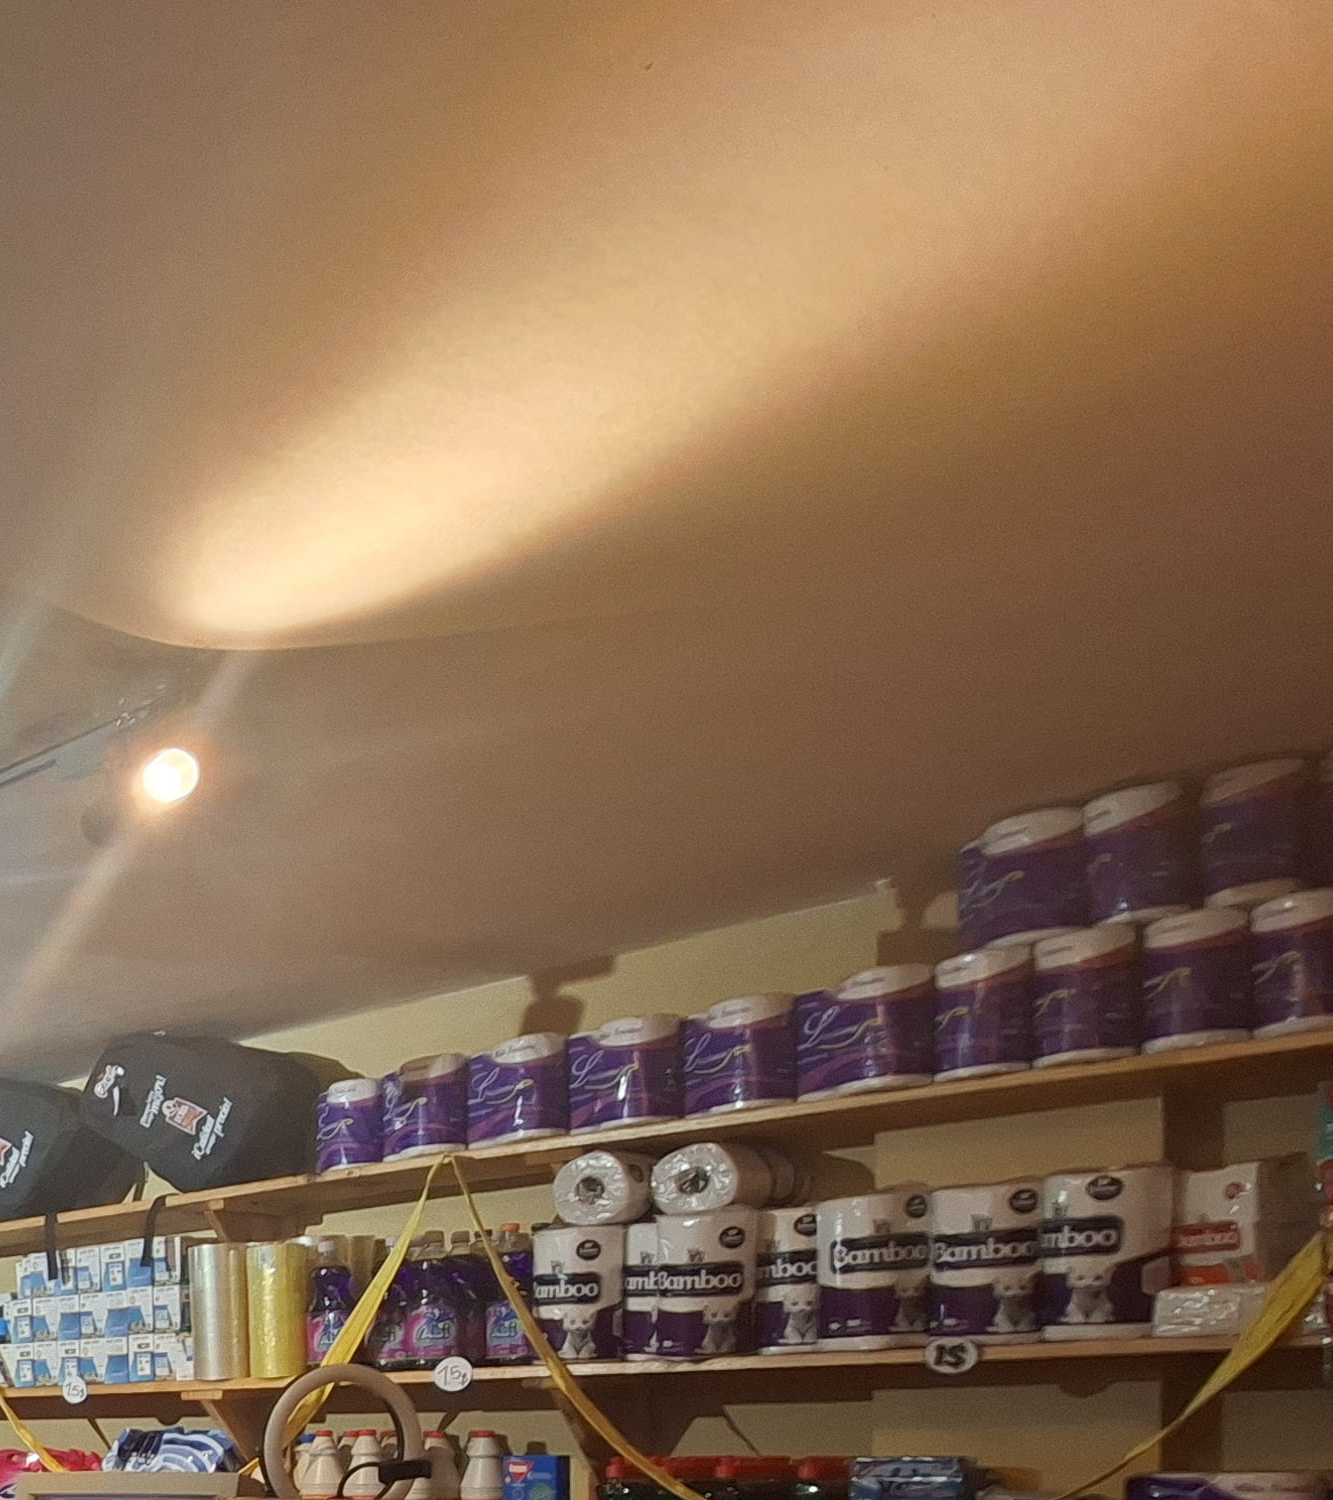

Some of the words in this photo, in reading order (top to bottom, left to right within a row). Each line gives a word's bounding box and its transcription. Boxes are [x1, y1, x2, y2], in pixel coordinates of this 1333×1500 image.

[1041, 1224, 1118, 1250] mboo
[763, 1250, 818, 1278] mboo
[534, 1273, 599, 1299] amboo
[658, 1265, 742, 1293] Bamboo
